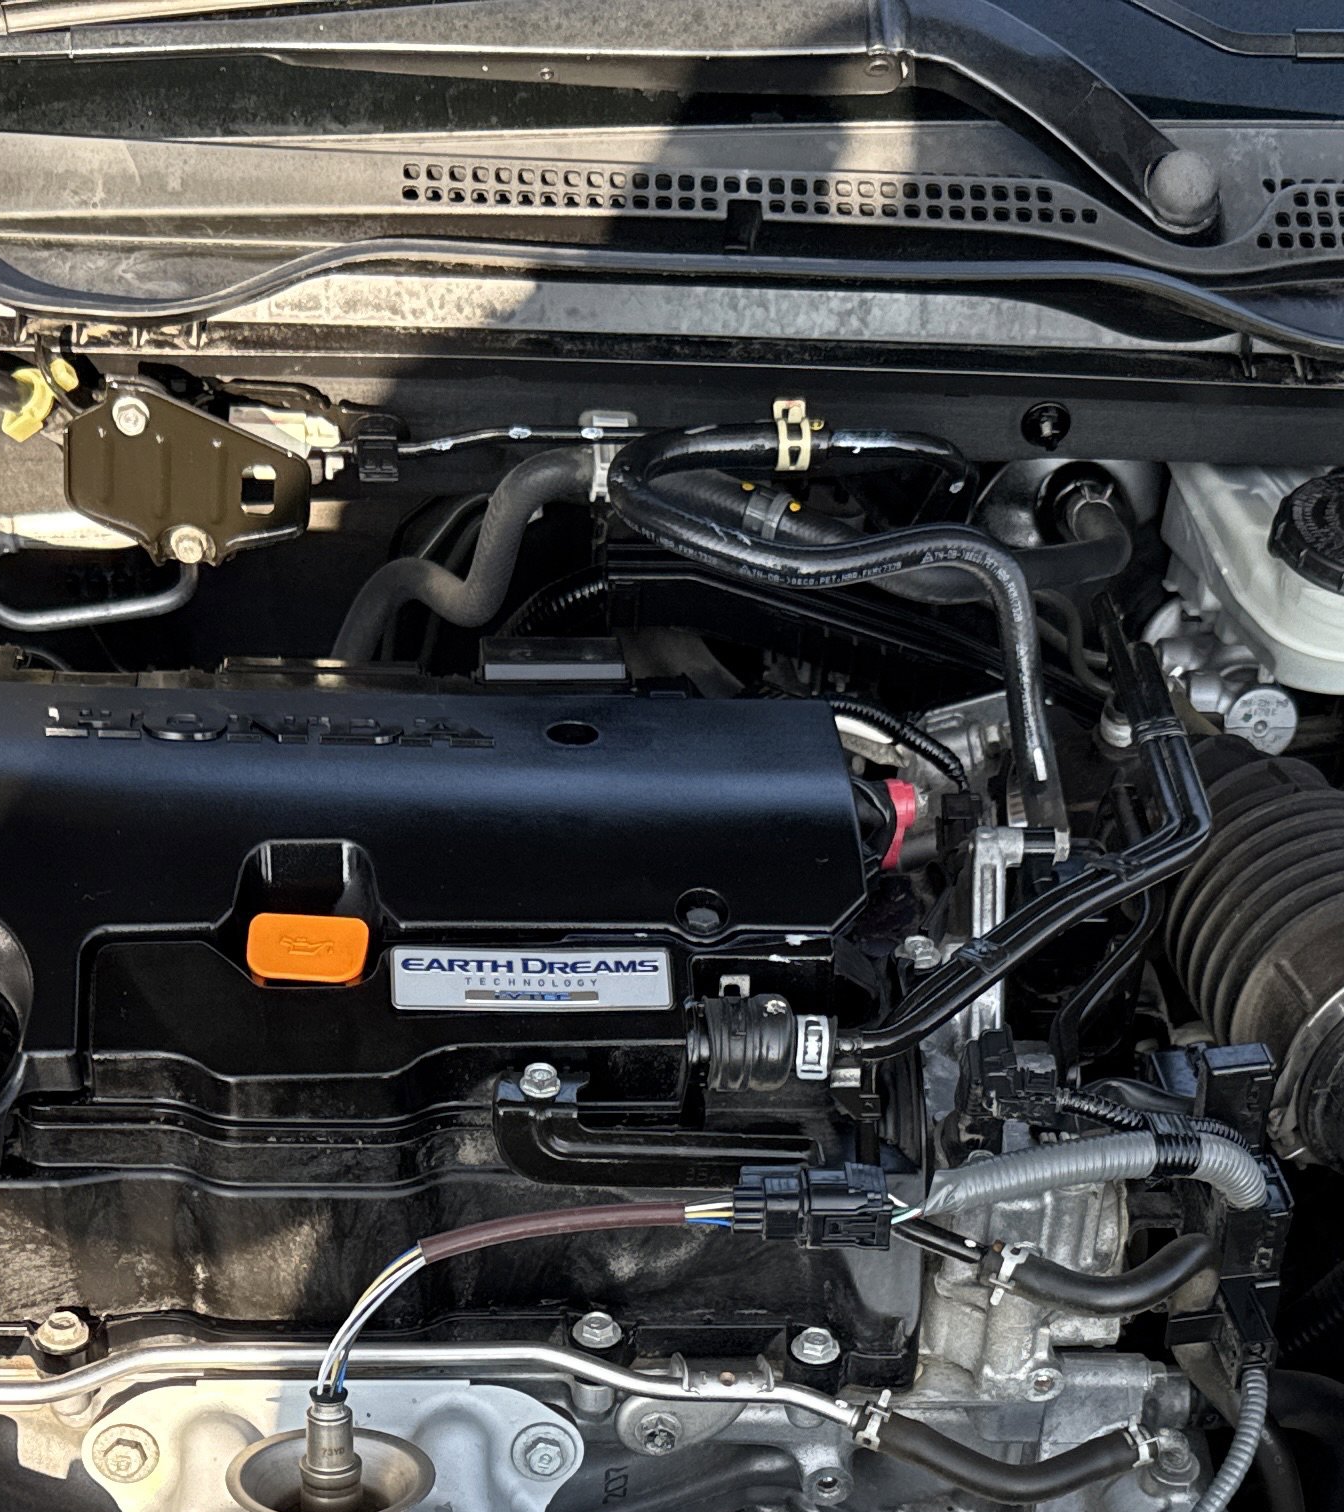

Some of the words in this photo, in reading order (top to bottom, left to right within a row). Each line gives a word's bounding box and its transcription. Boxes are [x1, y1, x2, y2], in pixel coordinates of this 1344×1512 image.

[45, 706, 495, 747] HONDA
[400, 957, 514, 974] EARTH
[520, 957, 660, 974] DREAMS
[464, 977, 598, 988] TECHNOLOGY
